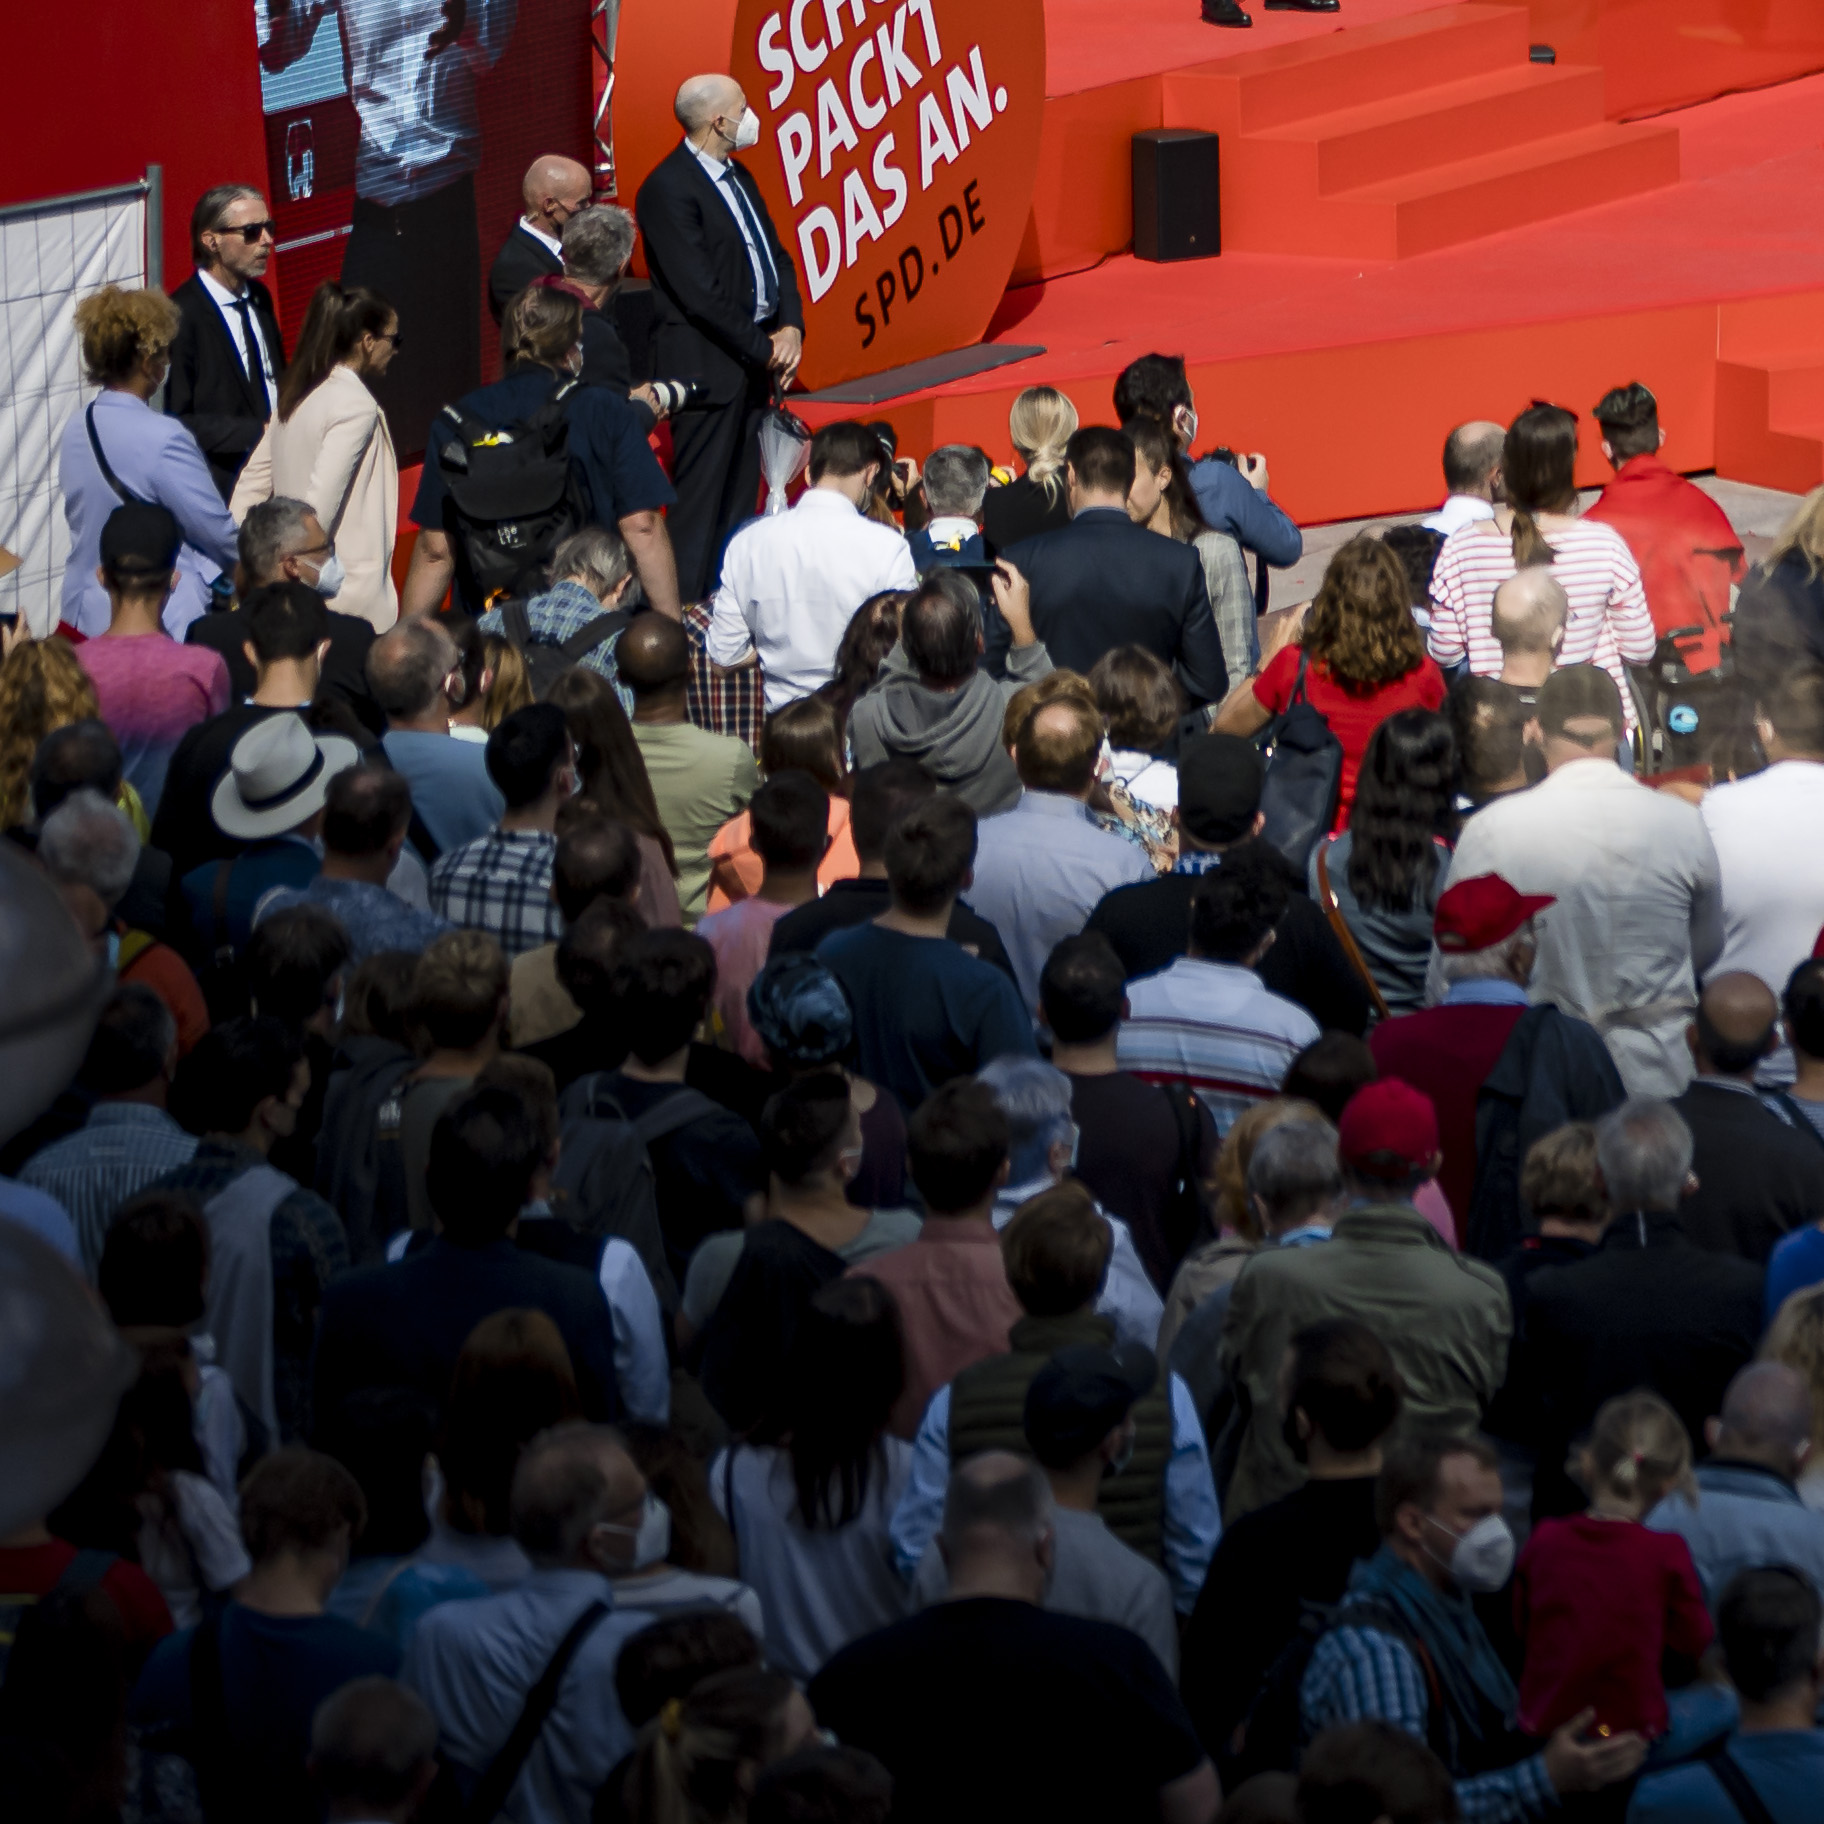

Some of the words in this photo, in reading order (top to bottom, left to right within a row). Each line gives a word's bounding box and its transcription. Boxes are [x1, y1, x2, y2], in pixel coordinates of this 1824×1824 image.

[797, 132, 908, 303] DAS
[919, 44, 1008, 190] AN.
[854, 178, 986, 348] SPD.DE
